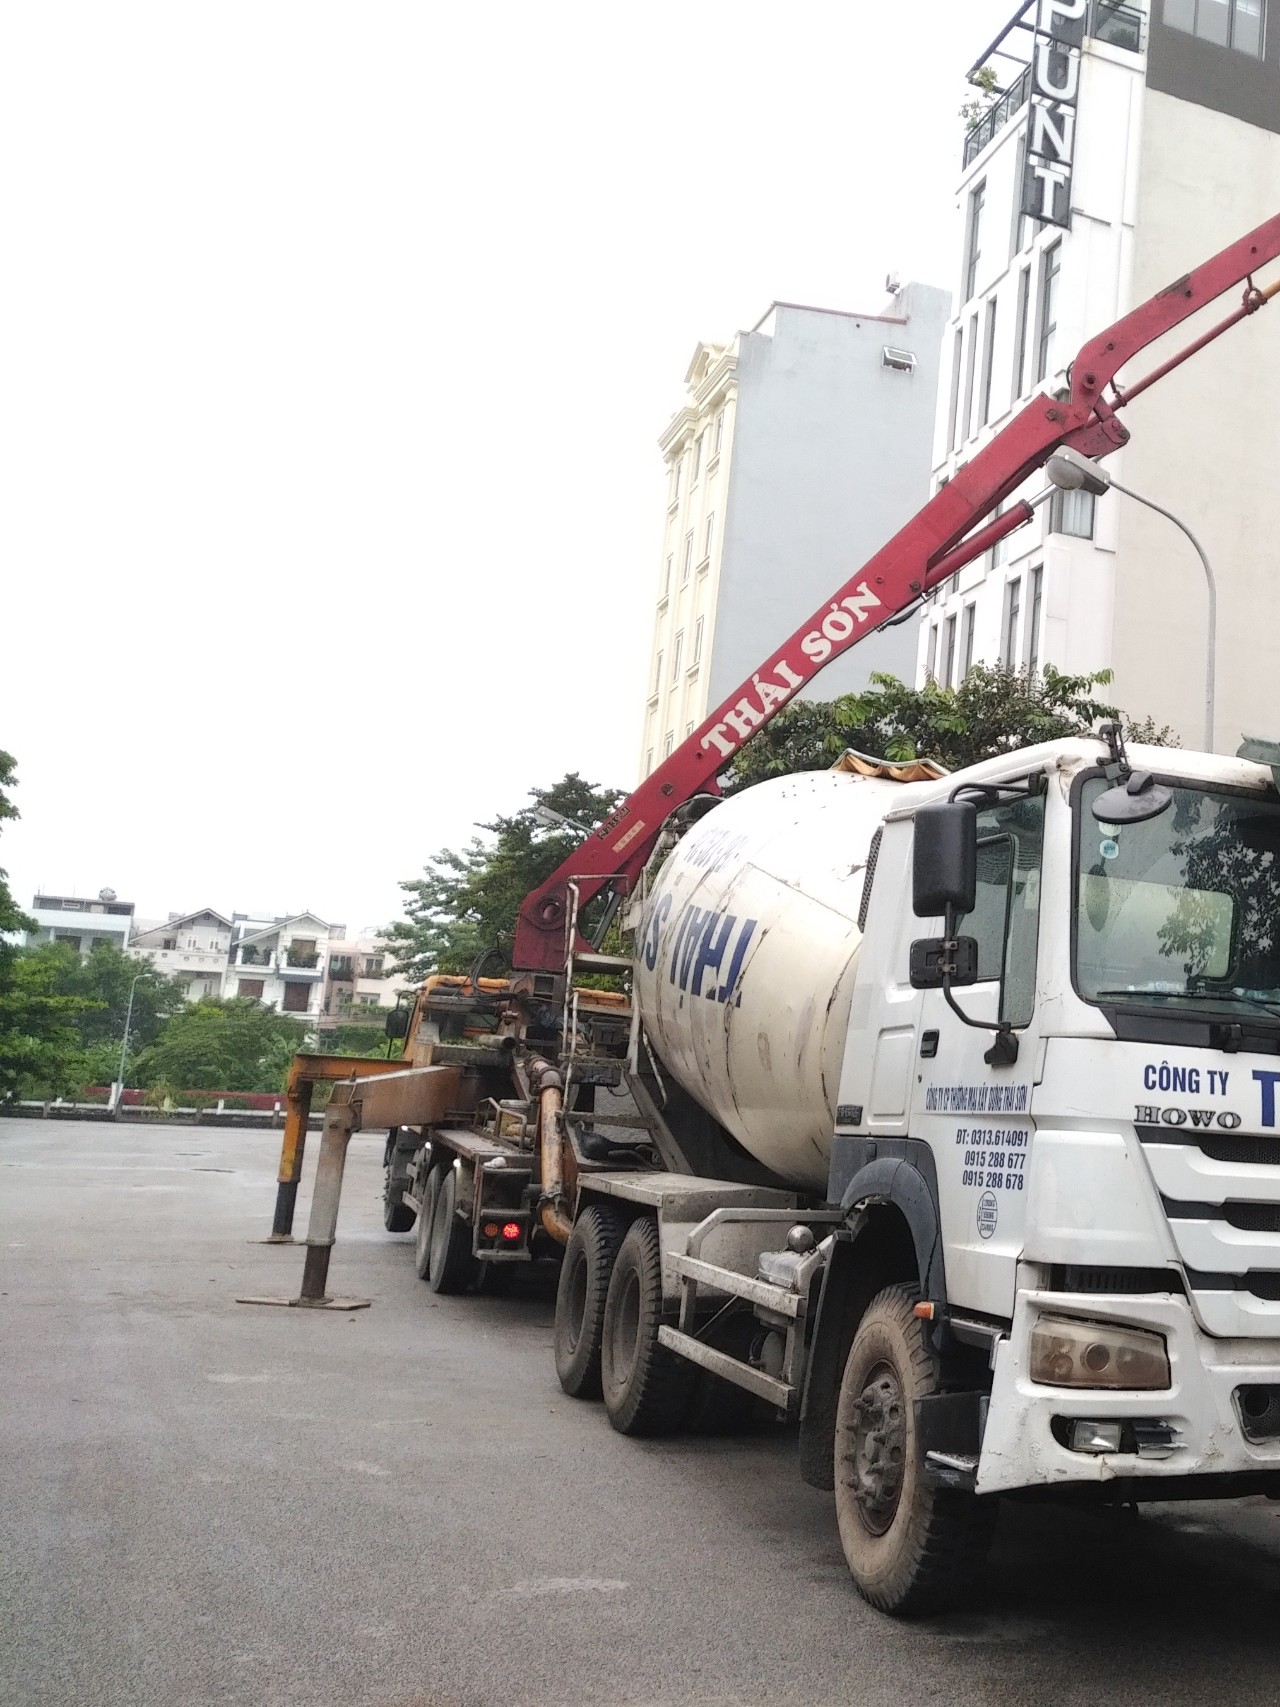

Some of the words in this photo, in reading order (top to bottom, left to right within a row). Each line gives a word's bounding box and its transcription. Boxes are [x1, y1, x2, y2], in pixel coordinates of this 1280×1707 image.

[801, 581, 881, 663] SƠN
[1144, 1060, 1200, 1094] CÔNG
[1207, 1070, 1229, 1096] TY
[1133, 1105, 1242, 1129] HOWO
[971, 1129, 1028, 1147] 0313.614091
[964, 1150, 986, 1167] 0915
[988, 1152, 1005, 1169] 288
[1007, 1153, 1026, 1170] 677
[962, 1170, 984, 1187] 0915
[986, 1171, 1003, 1189] 288
[1005, 1173, 1024, 1190] 678
